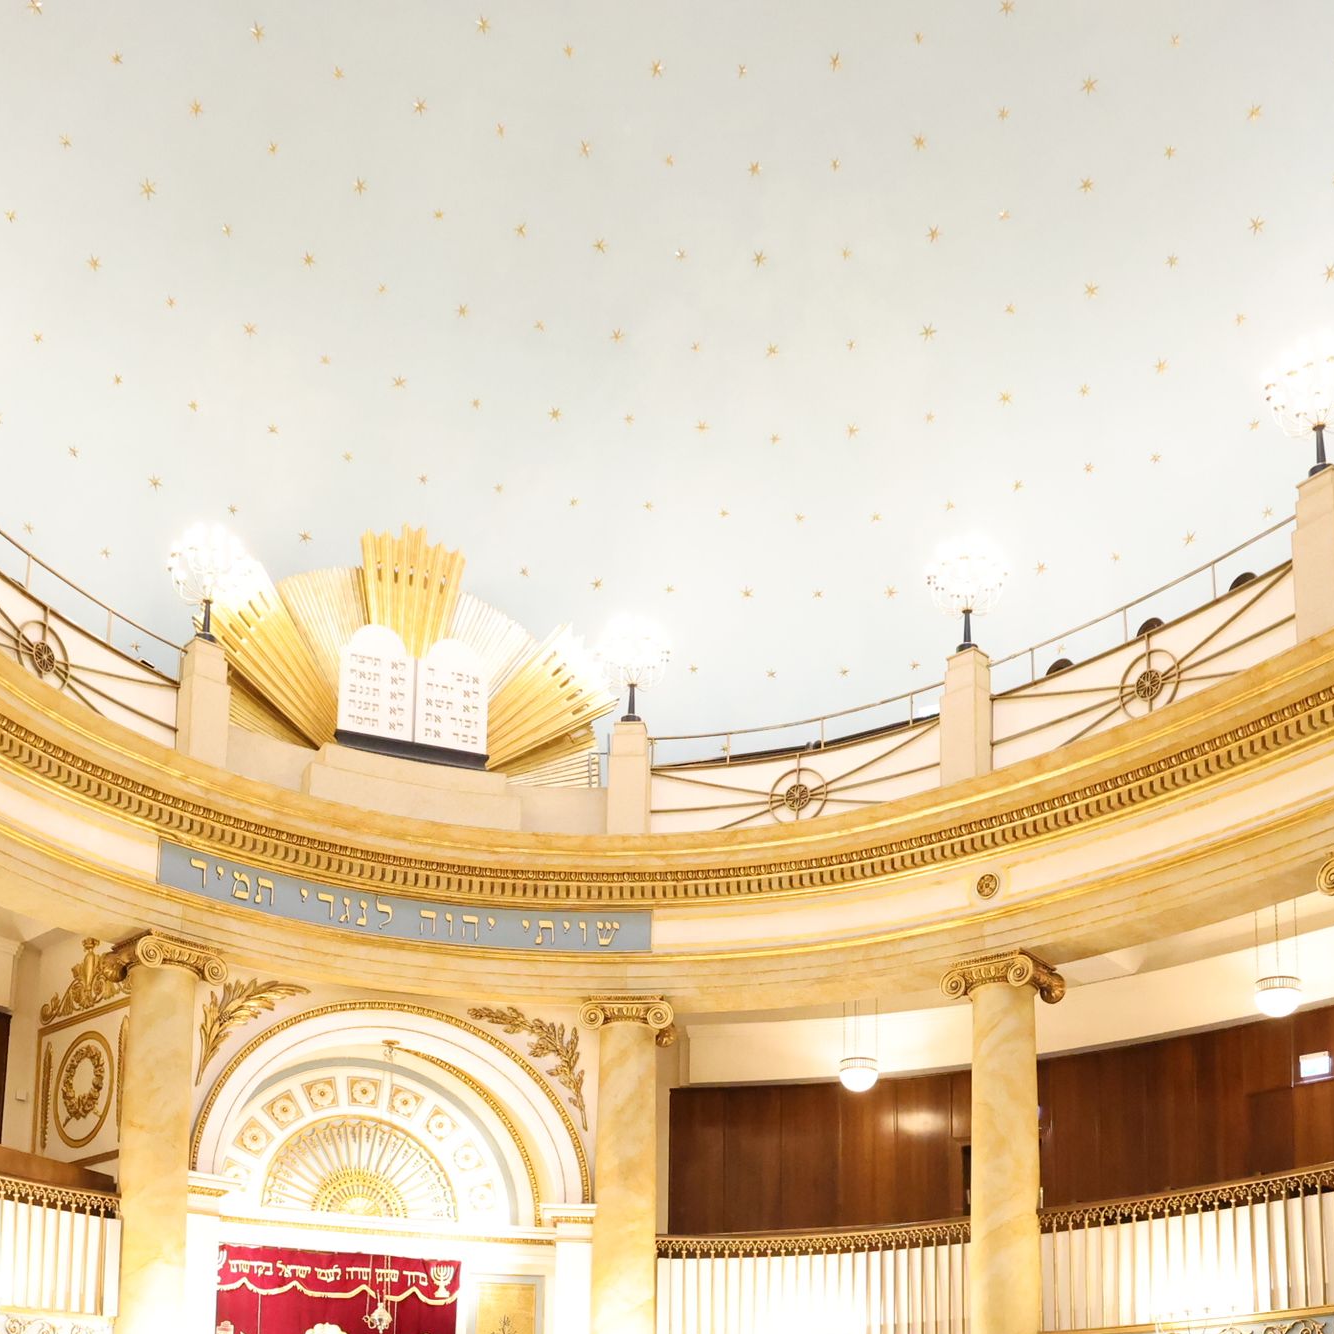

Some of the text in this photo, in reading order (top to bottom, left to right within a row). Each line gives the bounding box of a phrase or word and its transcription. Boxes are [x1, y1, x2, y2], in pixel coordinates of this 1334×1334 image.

[391, 658, 406, 670] לא
[391, 674, 405, 685] לא
[390, 690, 405, 700] לא
[463, 687, 479, 699] לא
[389, 705, 404, 715] לא
[463, 702, 478, 714] לא
[425, 712, 441, 723] את
[389, 720, 403, 730] לא
[425, 728, 441, 738] את
[189, 857, 621, 947] שויתי יהוה לנגדי תמיד
[276, 1260, 311, 1278] ישראל
